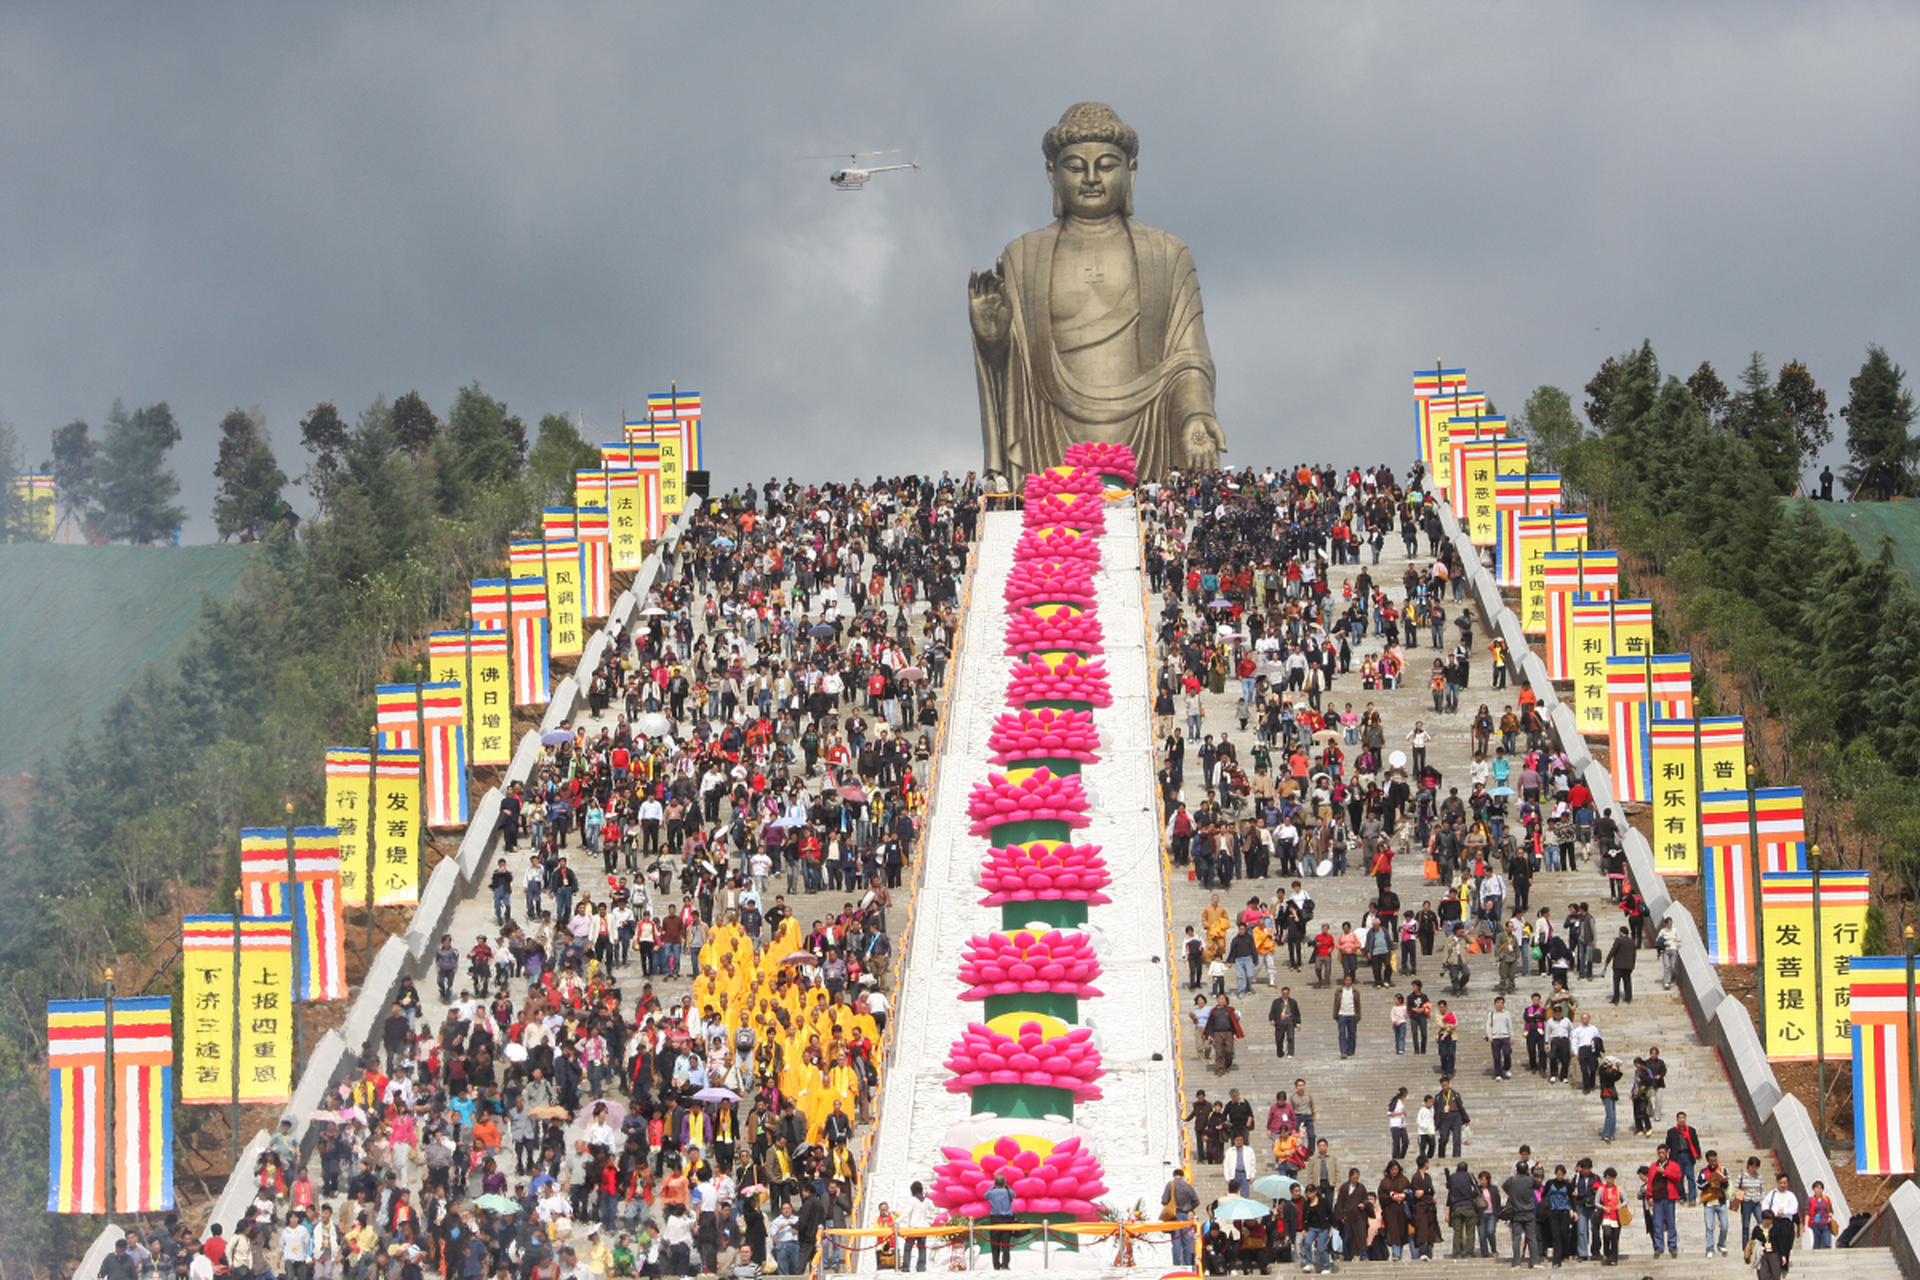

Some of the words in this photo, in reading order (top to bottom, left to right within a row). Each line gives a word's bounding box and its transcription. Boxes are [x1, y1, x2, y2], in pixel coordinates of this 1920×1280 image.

[1473, 469, 1491, 534] 诸恶莫作
[1583, 638, 1603, 721] 利乐有情
[1625, 636, 1644, 652] 普
[386, 792, 408, 890] 发菩提心
[1663, 762, 1687, 860] 利乐有情
[1776, 924, 1805, 1041] 发菩提心
